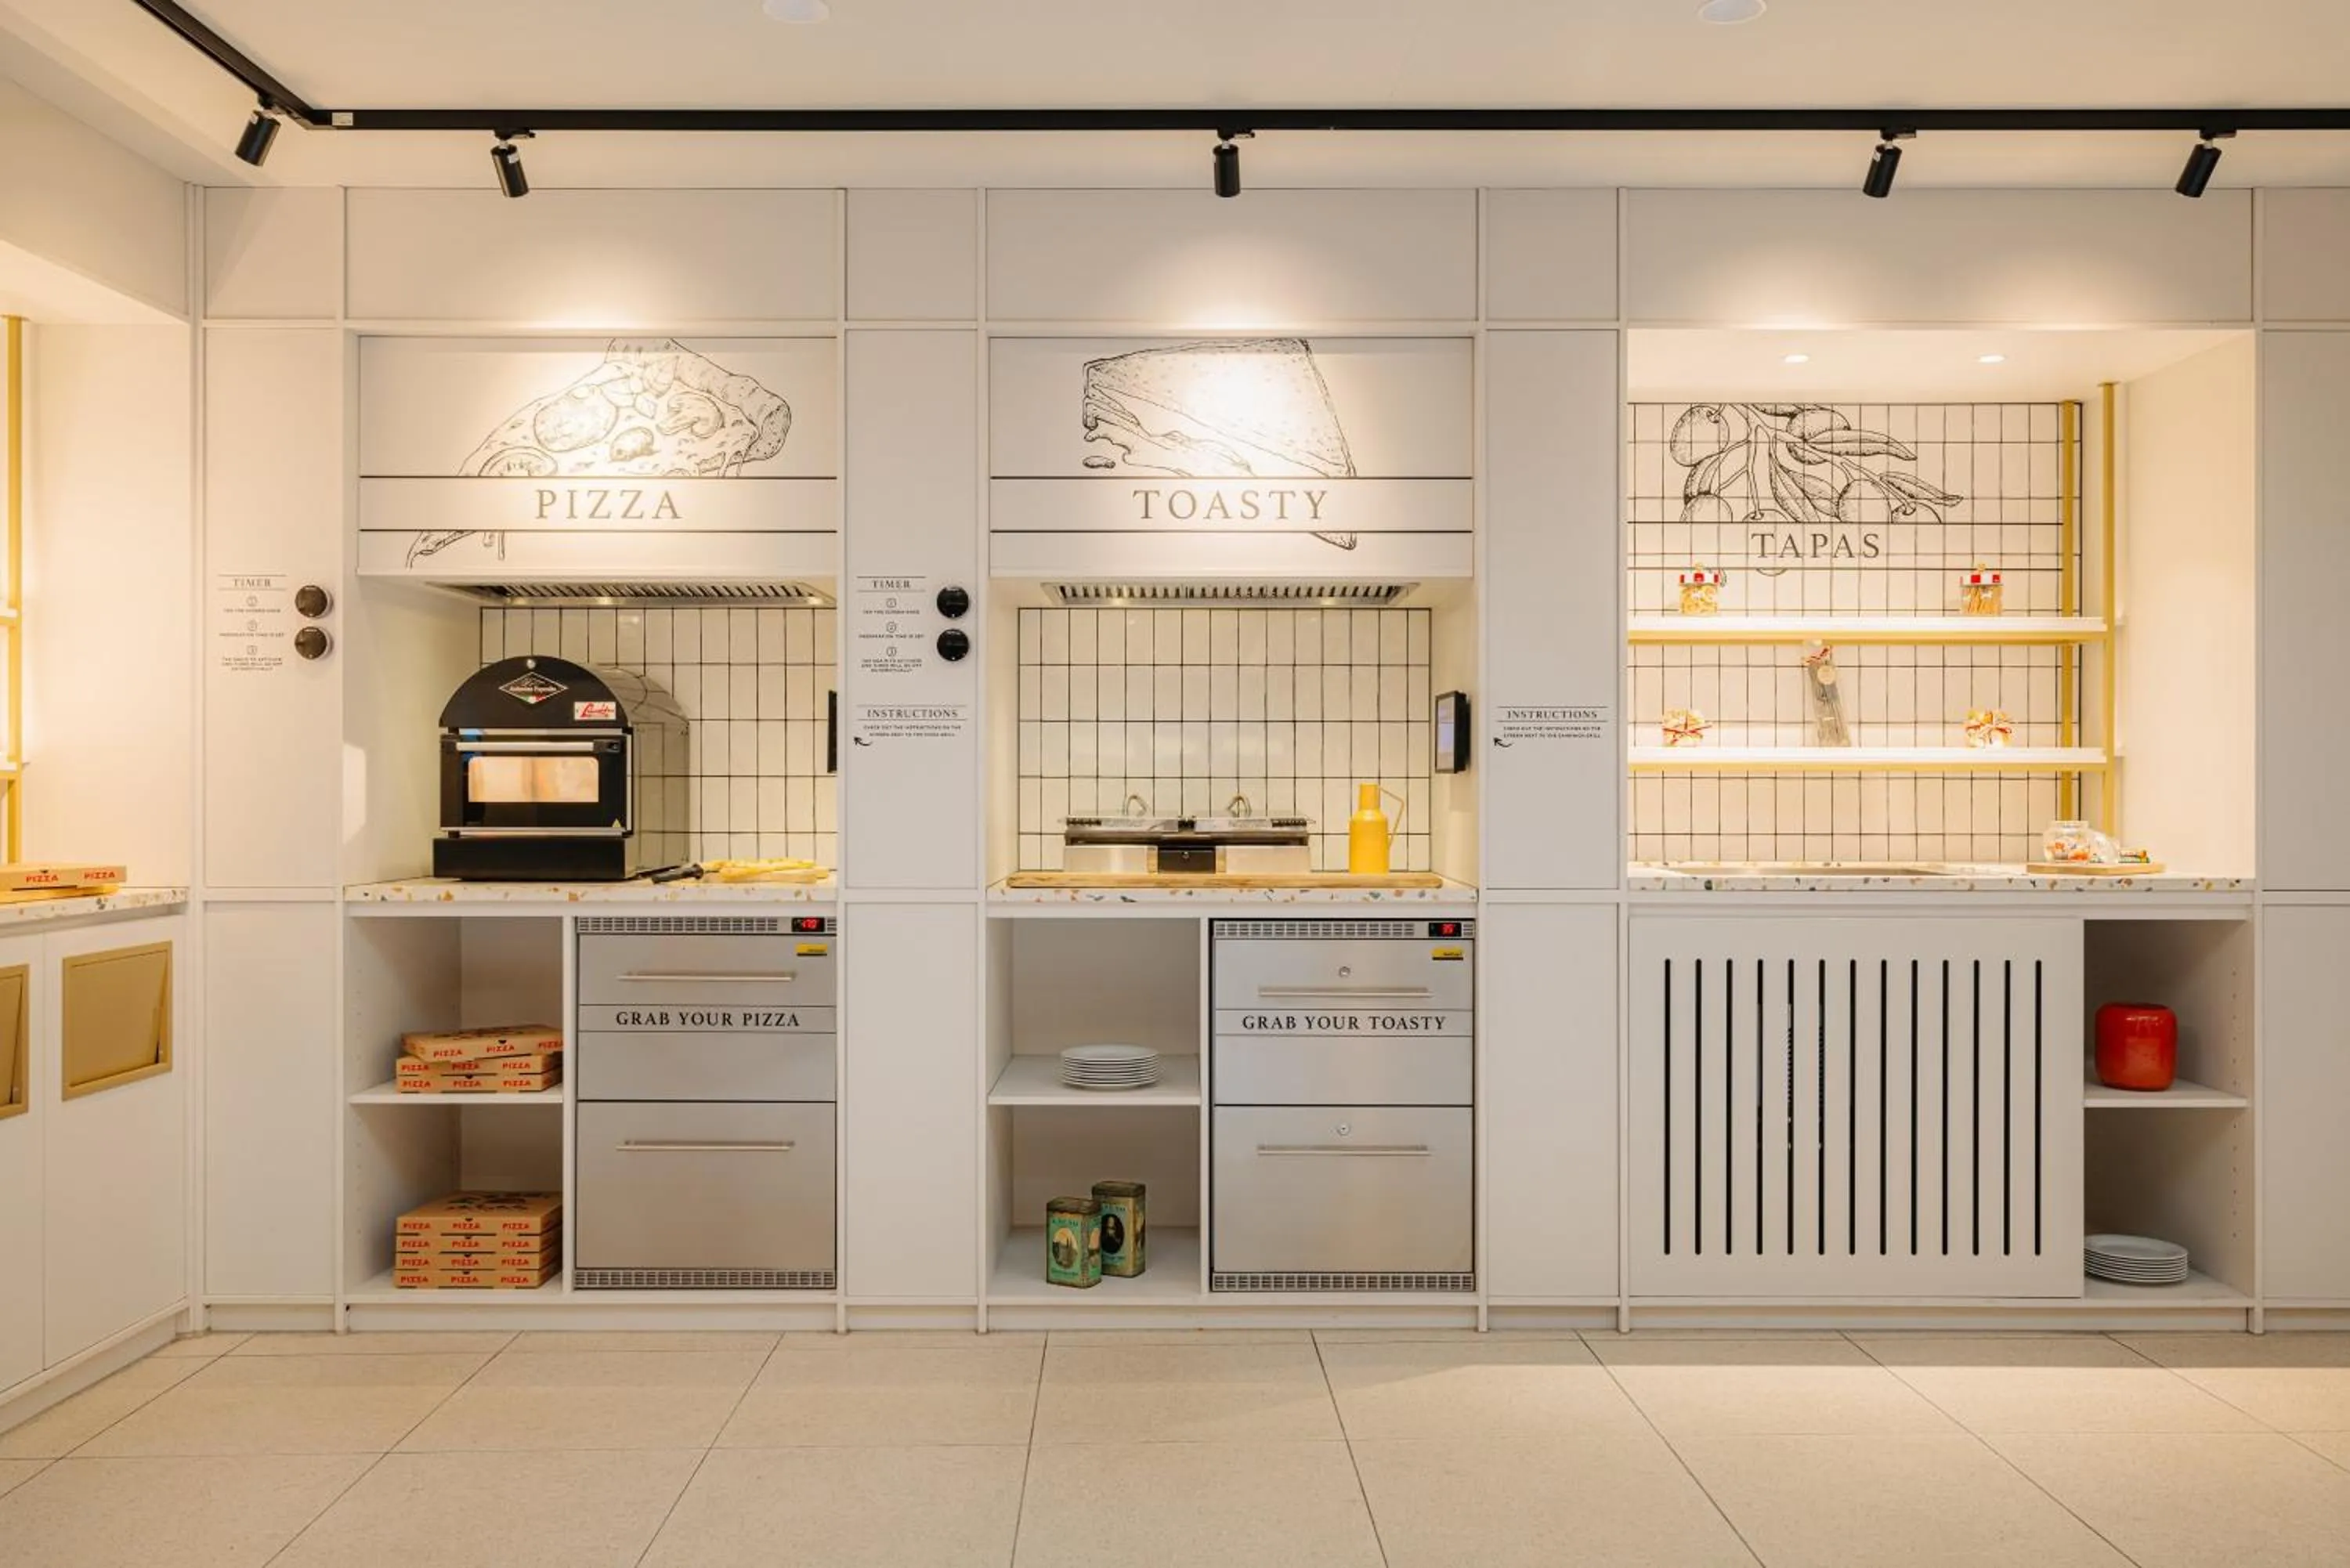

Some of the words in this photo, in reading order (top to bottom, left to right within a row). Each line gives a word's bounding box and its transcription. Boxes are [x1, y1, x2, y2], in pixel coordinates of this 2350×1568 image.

[535, 489, 683, 519] PIZZA
[1133, 490, 1328, 519] TOASTY
[1751, 533, 1880, 558] TAPAS
[867, 709, 958, 717] INSTRUCTIONS
[25, 874, 59, 883] PIZZA
[84, 871, 115, 880] PIZZA
[616, 1011, 670, 1025] GRAB
[679, 1012, 733, 1026] YOUR
[743, 1013, 800, 1027] PIZZA
[1242, 1016, 1296, 1030] GRAB
[1305, 1016, 1360, 1030] YOUR
[1368, 1016, 1445, 1030] TOASTY
[433, 1049, 463, 1058] PIZZA
[486, 1045, 515, 1053] PIZZA
[403, 1222, 431, 1230] PIZZA
[452, 1222, 480, 1230] PIZZA
[502, 1222, 530, 1230] PIZZA
[401, 1240, 430, 1248] PIZZA
[451, 1240, 479, 1248] PIZZA
[501, 1240, 530, 1248] PIZZA
[401, 1258, 429, 1266] PIZZA
[450, 1258, 479, 1266] PIZZA
[501, 1258, 529, 1266] PIZZA
